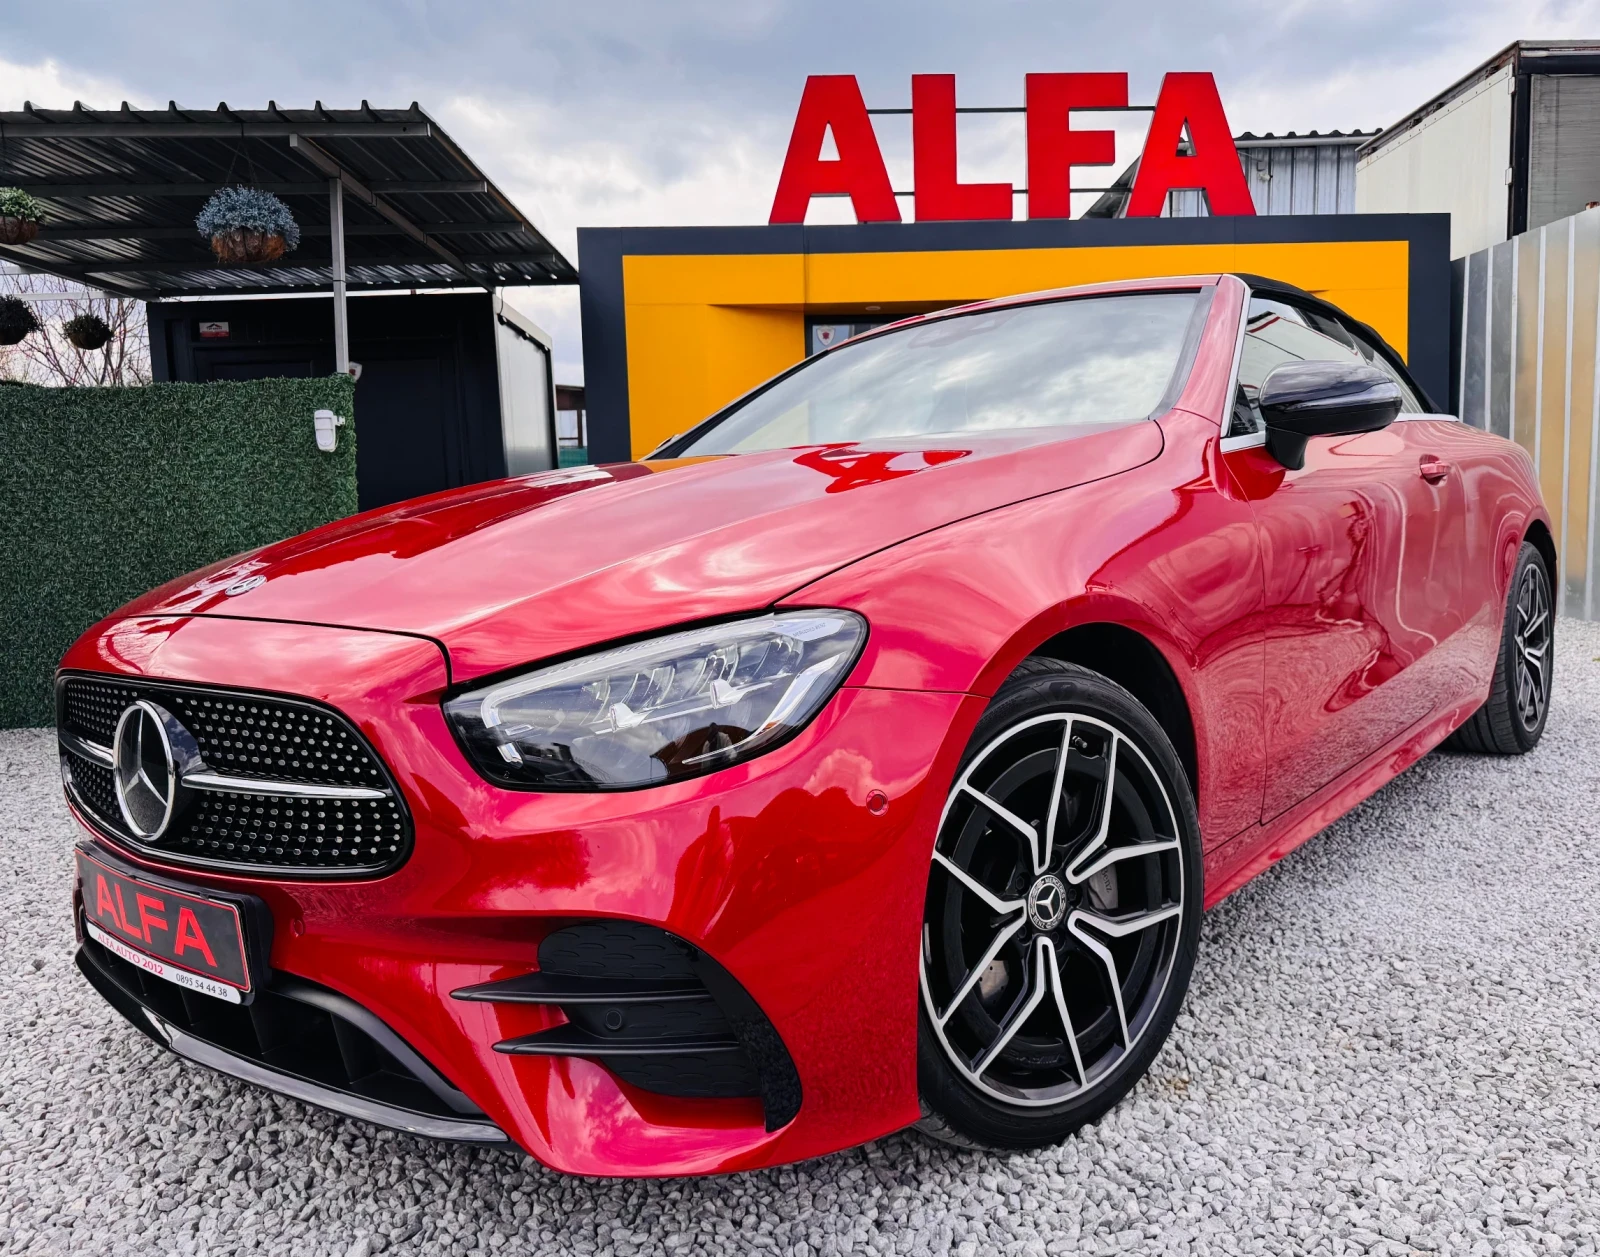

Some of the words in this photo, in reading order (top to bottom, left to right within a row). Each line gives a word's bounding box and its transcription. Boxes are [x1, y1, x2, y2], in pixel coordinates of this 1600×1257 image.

[768, 72, 1257, 224] ALFA
[96, 873, 218, 968] ALFA
[97, 932, 115, 951] ALFA
[116, 945, 141, 964] AUTO
[142, 957, 164, 976] 2012
[175, 973, 193, 986] 0895
[195, 979, 204, 990] 54
[206, 984, 216, 994] 44
[218, 986, 228, 998] 38
